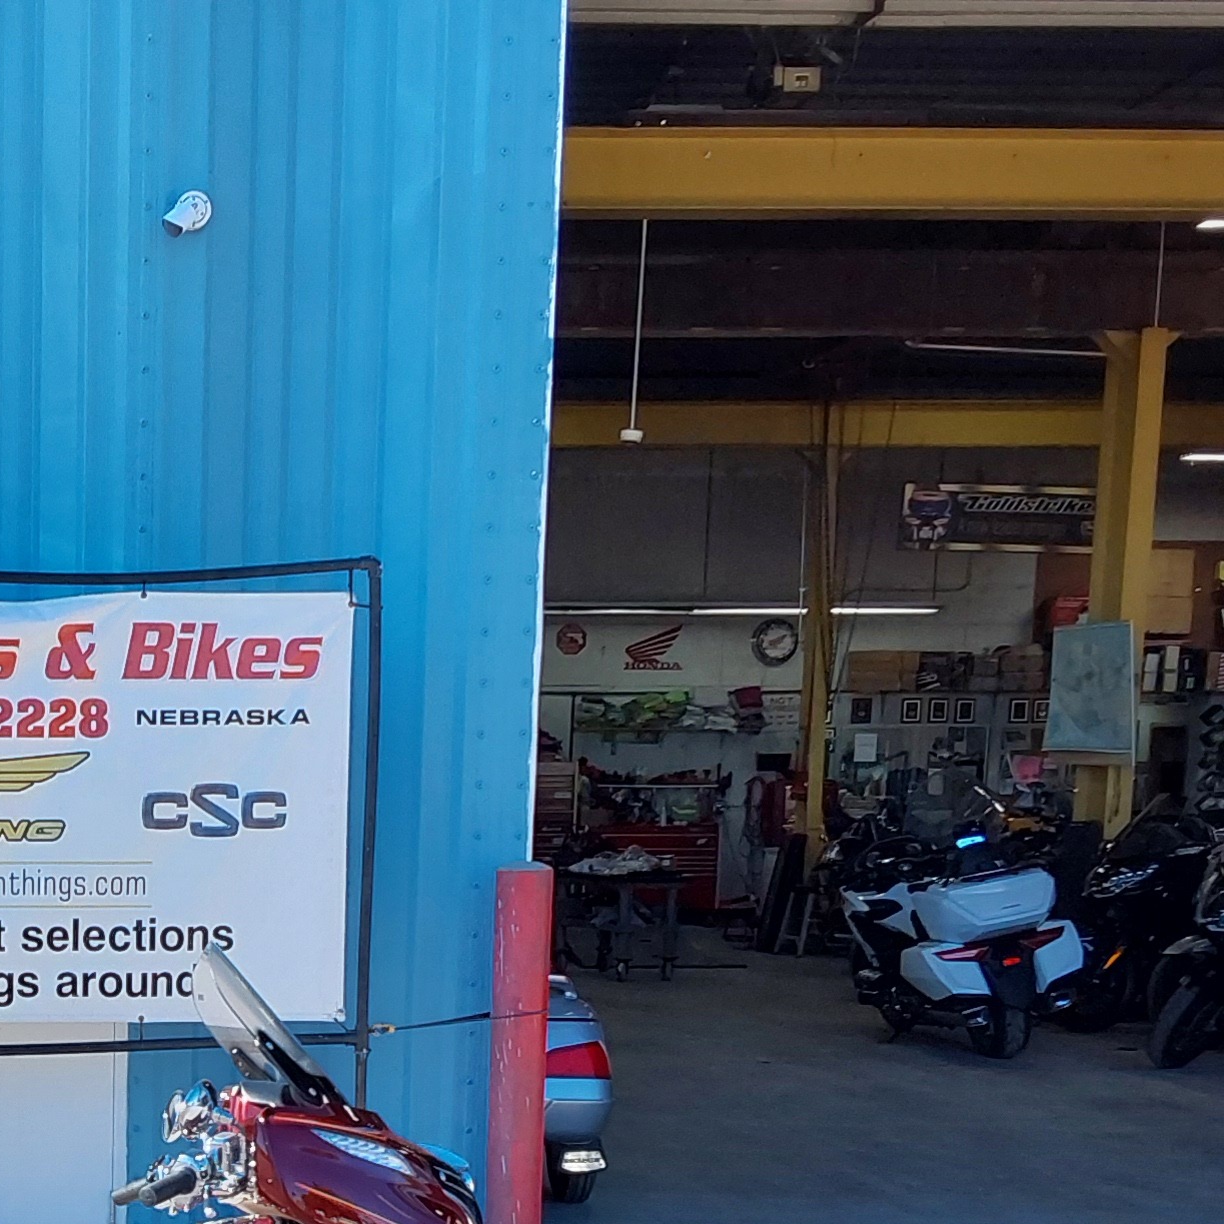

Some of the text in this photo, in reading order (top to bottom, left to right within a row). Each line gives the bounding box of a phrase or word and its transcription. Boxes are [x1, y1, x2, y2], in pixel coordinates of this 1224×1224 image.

[44, 622, 97, 680] &
[121, 622, 324, 680] Bikes
[623, 660, 683, 670] HONDA
[135, 708, 310, 726] NEBRASKA
[21, 917, 234, 951] selections
